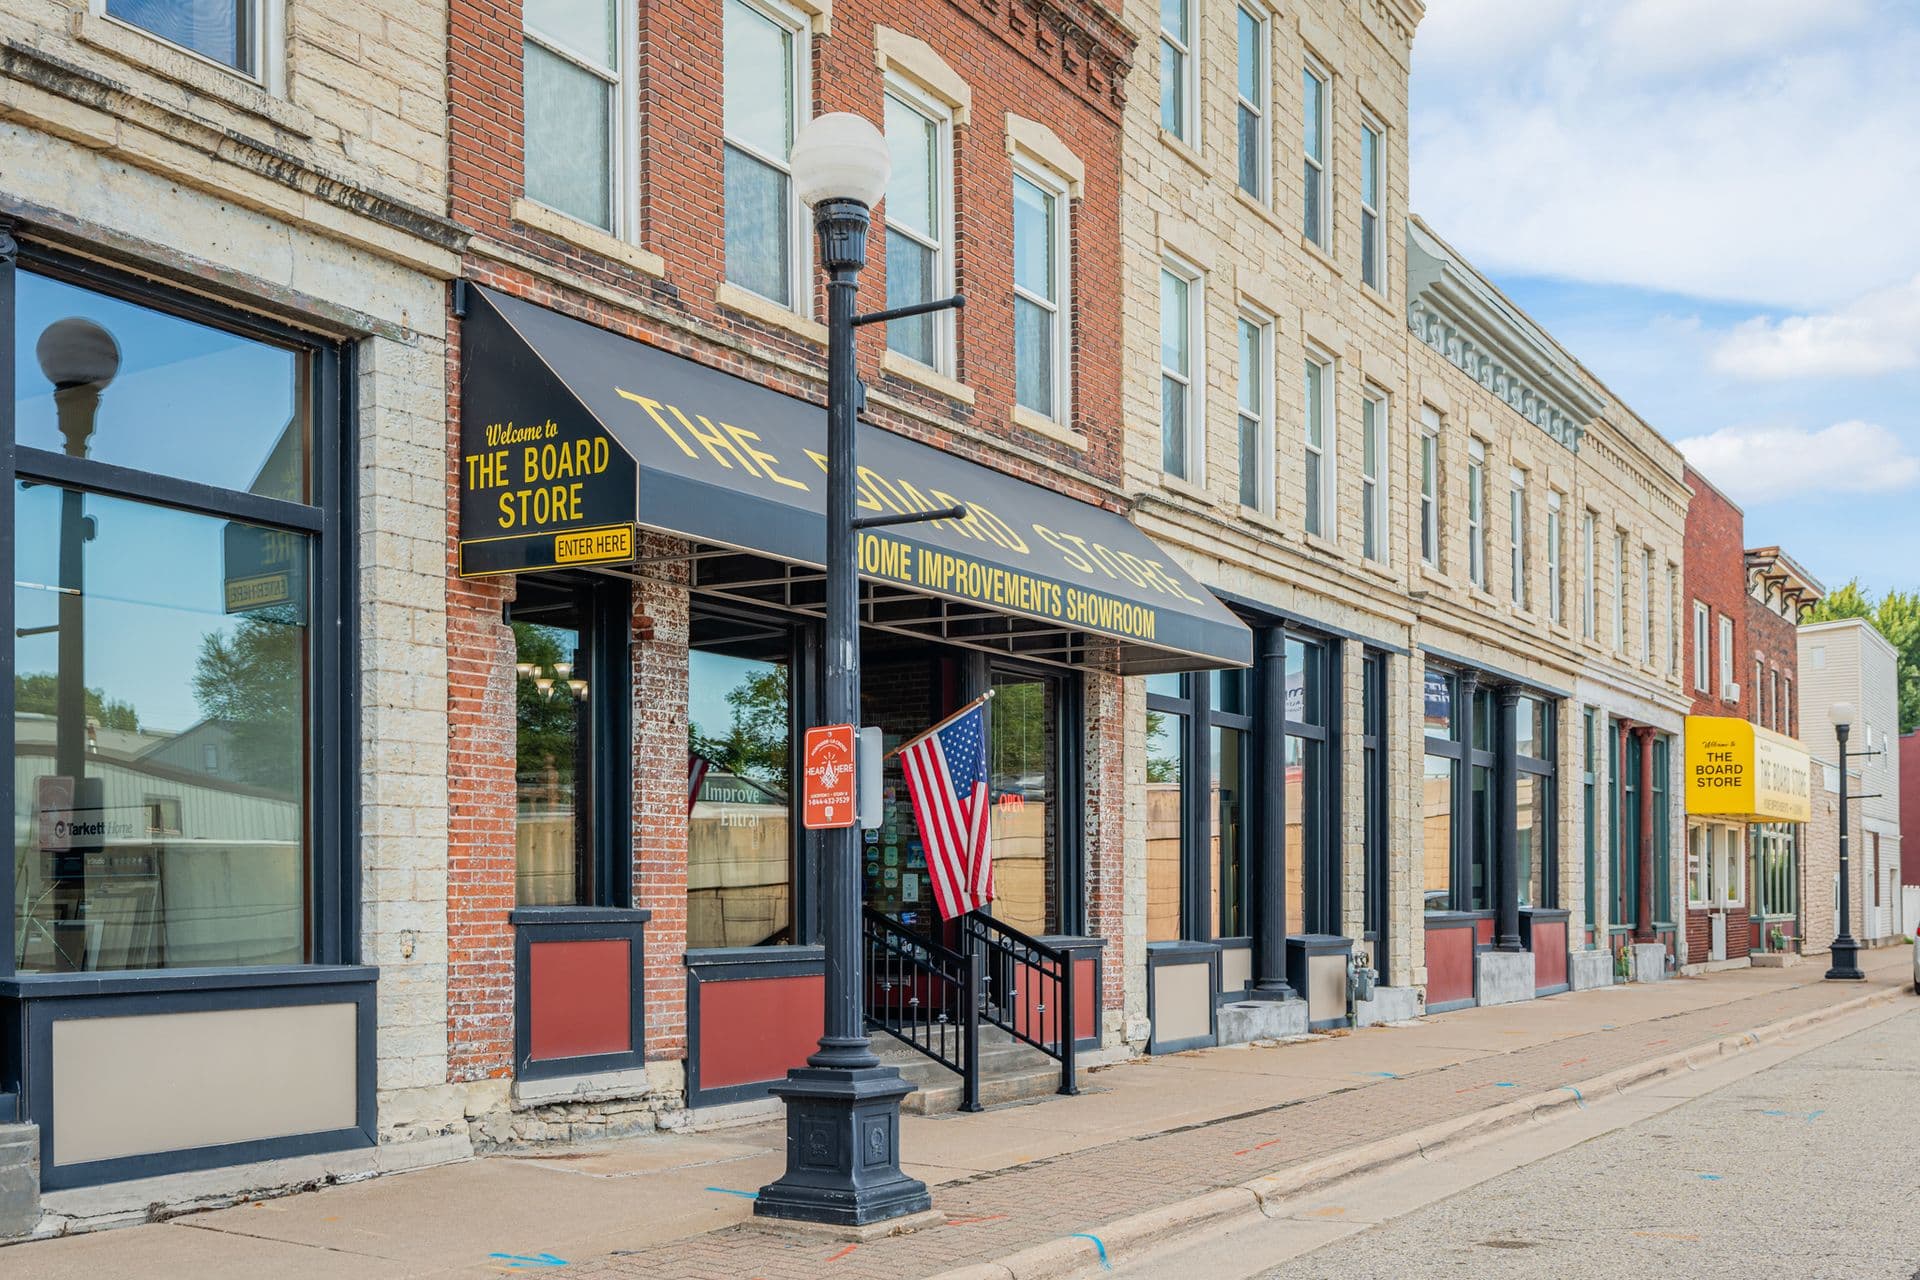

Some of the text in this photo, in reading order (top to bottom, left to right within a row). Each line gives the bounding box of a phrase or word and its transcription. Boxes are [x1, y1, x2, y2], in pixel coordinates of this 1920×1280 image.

[486, 419, 559, 447] Welcome to
[465, 436, 610, 491] THE BOARD
[498, 482, 584, 529] STORE
[614, 385, 810, 492] THE
[1032, 523, 1204, 606] STORE
[558, 534, 627, 557] ENTER HERE
[918, 549, 1062, 617] IMPROVEMENTS
[1066, 588, 1156, 640] SHOWROOM
[1707, 752, 1733, 762] THE
[806, 763, 854, 776] HEAR HERE
[1696, 764, 1744, 775] BOARD
[1697, 777, 1742, 788] STORE
[999, 793, 1025, 813] OPEN
[66, 821, 105, 836] Tarkett
